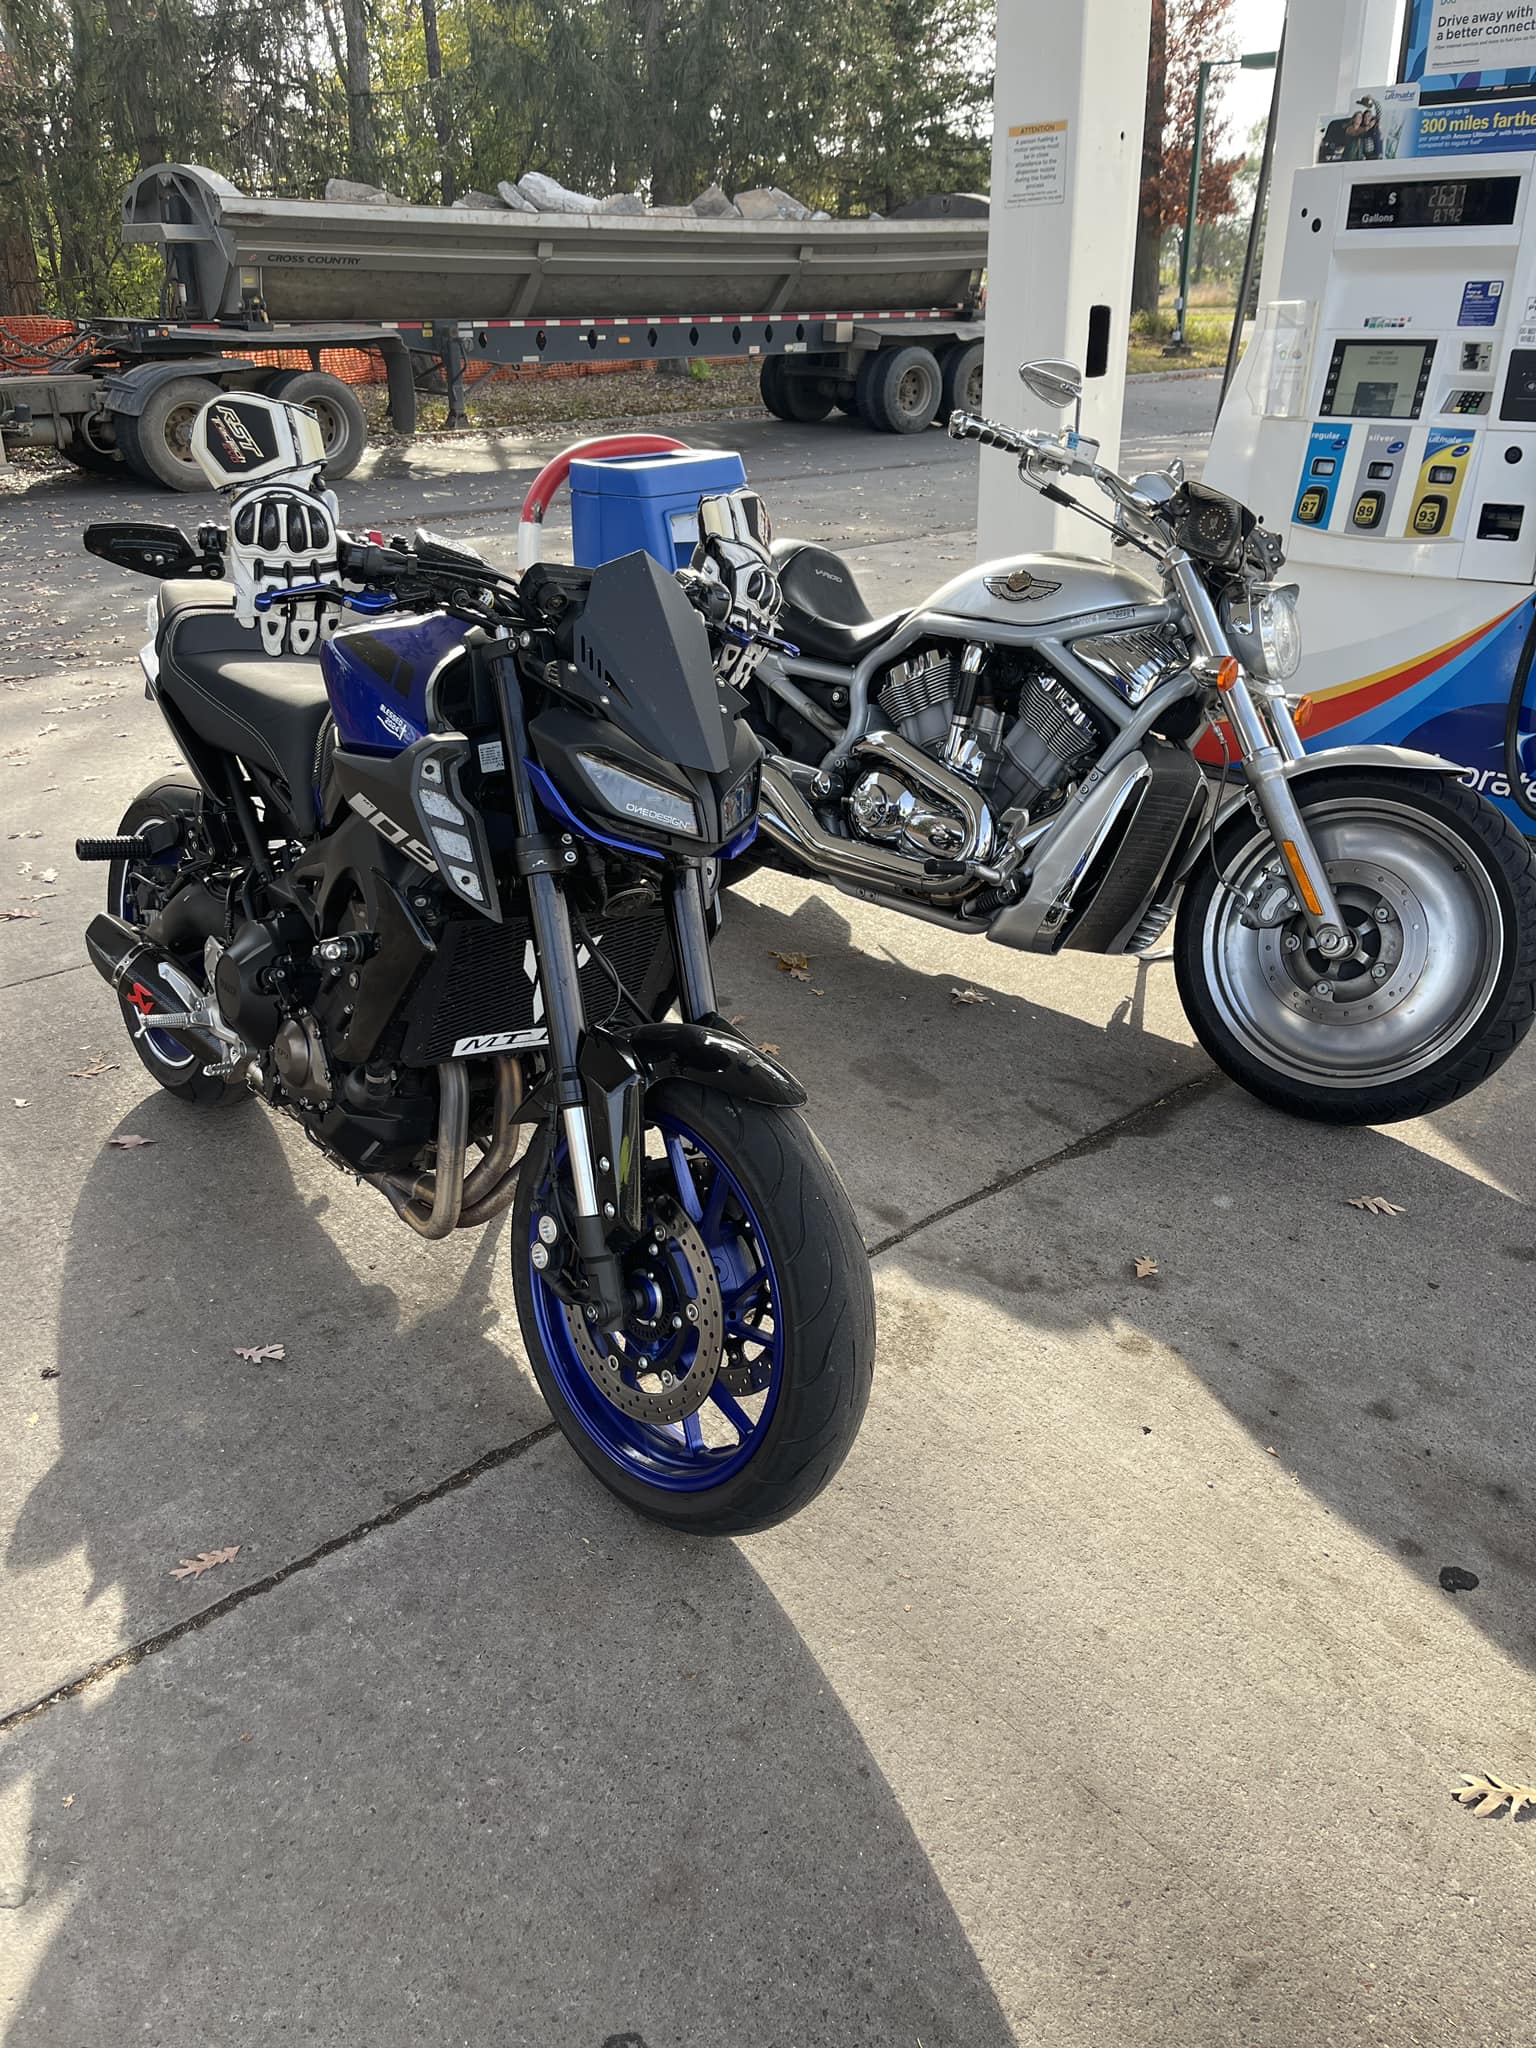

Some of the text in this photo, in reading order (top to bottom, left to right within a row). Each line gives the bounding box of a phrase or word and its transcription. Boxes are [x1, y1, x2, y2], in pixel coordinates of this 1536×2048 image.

[1438, 5, 1534, 28] Drive away with
[1436, 32, 1443, 41] a
[1446, 27, 1483, 40] better
[1420, 110, 1536, 134] 300 miles farthe
[1020, 124, 1056, 135] ATTENTION
[1362, 212, 1394, 224] Gallons
[267, 254, 360, 265] CROSS COUNTRY
[216, 405, 264, 458] RST
[1311, 432, 1340, 440] regular
[1301, 501, 1317, 512] 87
[1357, 506, 1374, 517] 89
[1418, 511, 1436, 523] 93
